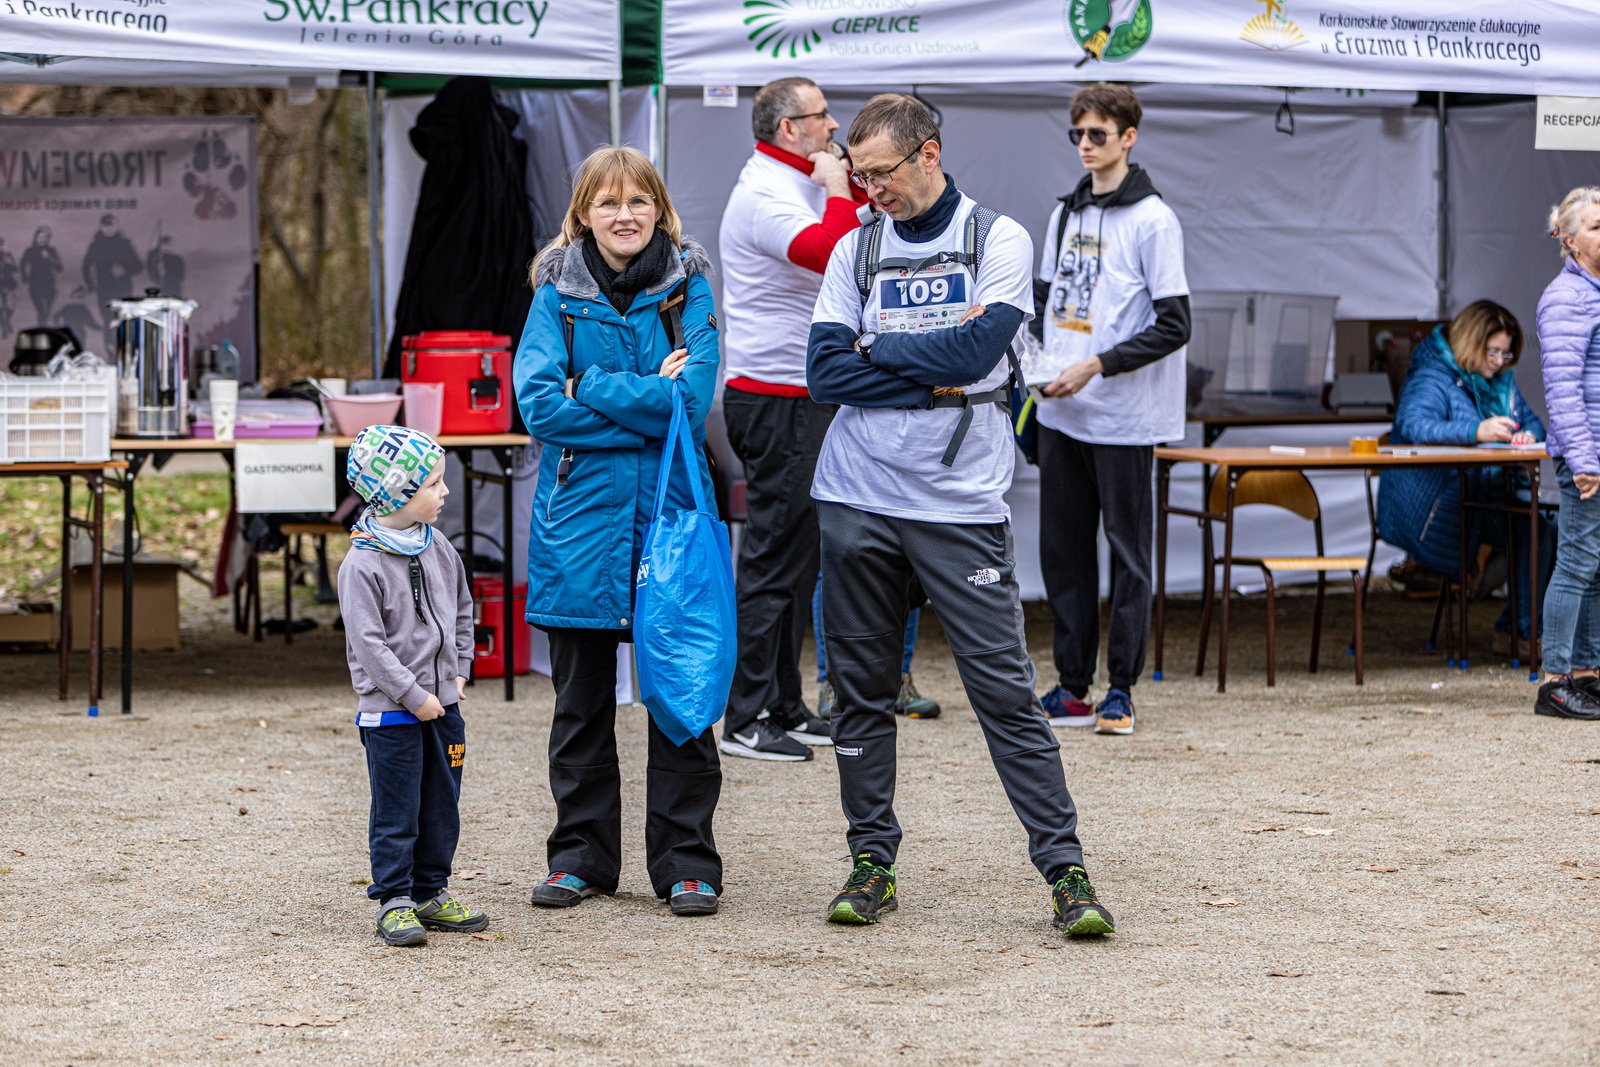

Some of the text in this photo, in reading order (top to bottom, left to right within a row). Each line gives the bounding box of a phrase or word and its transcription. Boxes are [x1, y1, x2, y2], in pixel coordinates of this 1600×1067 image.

[832, 16, 921, 34] CIEPLICE
[1319, 12, 1541, 37] Karkonoskie Stowarzyszenie Edukacyjne
[300, 27, 503, 46] Jelenia Góra
[873, 42, 912, 57] Grupa
[1334, 31, 1408, 57] Erazma
[1413, 33, 1423, 58] i
[1427, 35, 1541, 67] Pankracego
[896, 278, 949, 306] 109
[244, 463, 324, 475] GASTRONOMIA
